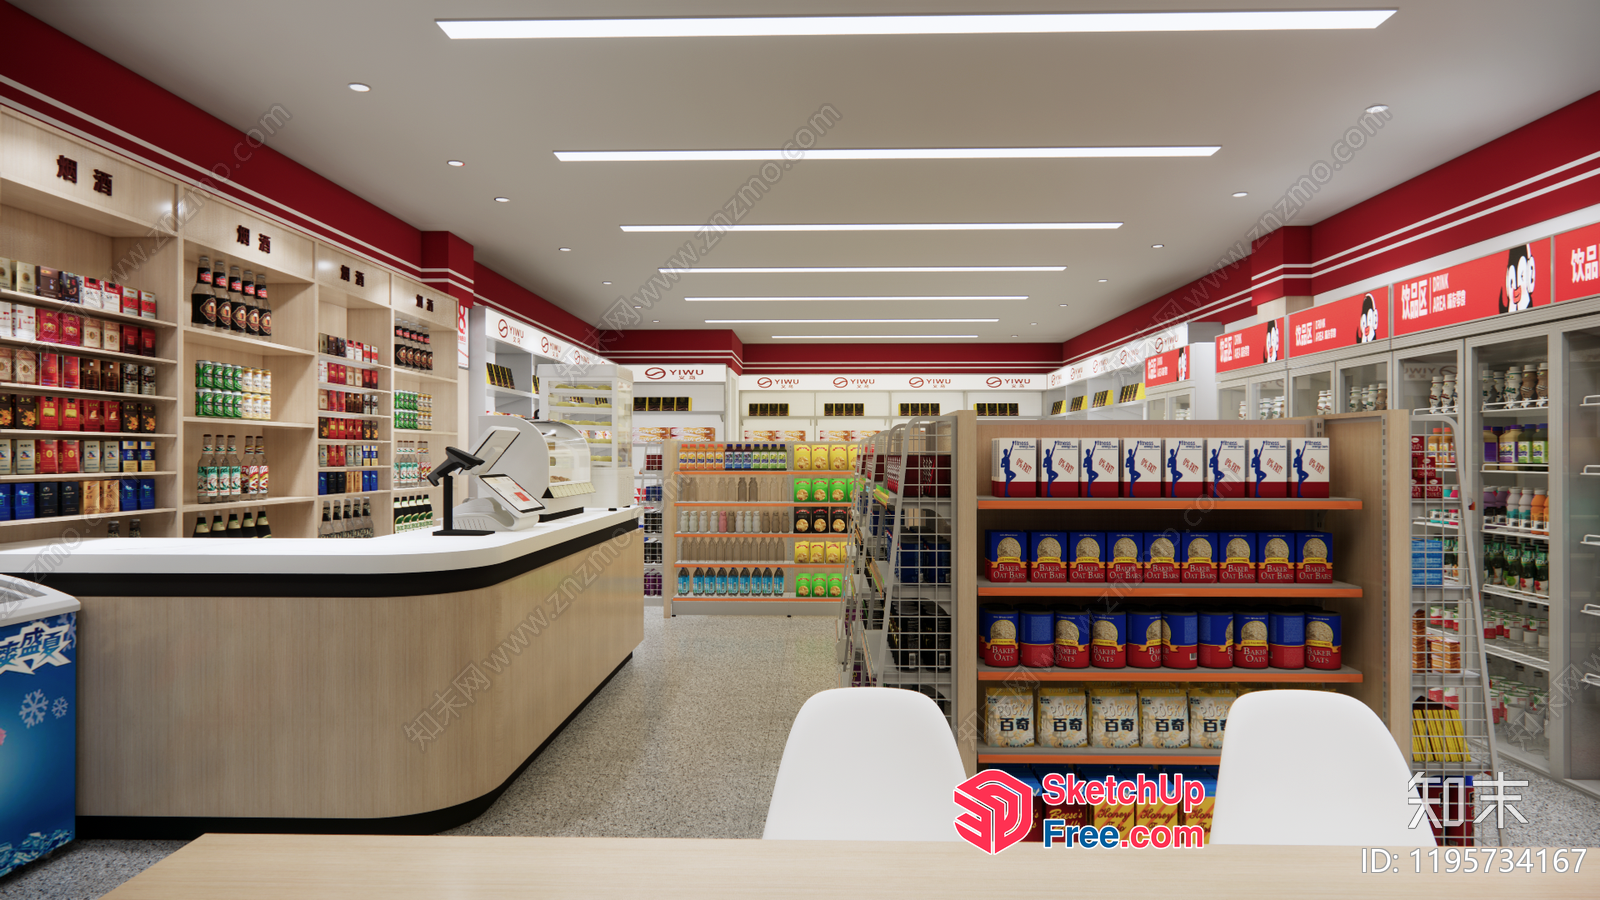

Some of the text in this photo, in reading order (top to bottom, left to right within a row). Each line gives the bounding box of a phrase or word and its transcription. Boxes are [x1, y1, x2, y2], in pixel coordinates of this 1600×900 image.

[56, 155, 113, 196] 烟酒
[237, 225, 271, 254] 烟酒
[1571, 244, 1600, 284] 饮品
[341, 265, 364, 287] 烟酒
[1432, 272, 1449, 293] DRINK
[416, 294, 434, 312] 烟酒
[1401, 279, 1428, 320] 饮品区
[1432, 294, 1447, 313] AREA
[1295, 322, 1313, 346] 饮品区
[999, 564, 1019, 572] BAKER
[1039, 564, 1060, 572] BAKER
[1078, 564, 1098, 572] BAKER
[1116, 564, 1136, 572] BAKER
[1147, 572, 1179, 580] OAT BARS
[1184, 572, 1216, 580] OAT BARS
[1222, 572, 1254, 580] OAT BARS
[1261, 572, 1292, 580] OAT BARS
[1299, 572, 1331, 580] OAT BARS
[992, 646, 1015, 654] BAKER
[1093, 646, 1116, 655] BAKER
[1244, 647, 1266, 655] BAKER
[1307, 648, 1331, 657] BAKER
[993, 653, 1014, 661] OATS
[1094, 653, 1114, 662] OATS
[1246, 654, 1266, 663] OATS
[1308, 655, 1329, 664] OATS
[1000, 718, 1029, 731] 百奇
[1053, 718, 1083, 732] 百奇
[1105, 719, 1134, 732] 百奇
[1155, 718, 1184, 732] 百奇
[1098, 807, 1132, 822] Honey
[1140, 808, 1176, 823] Honey
